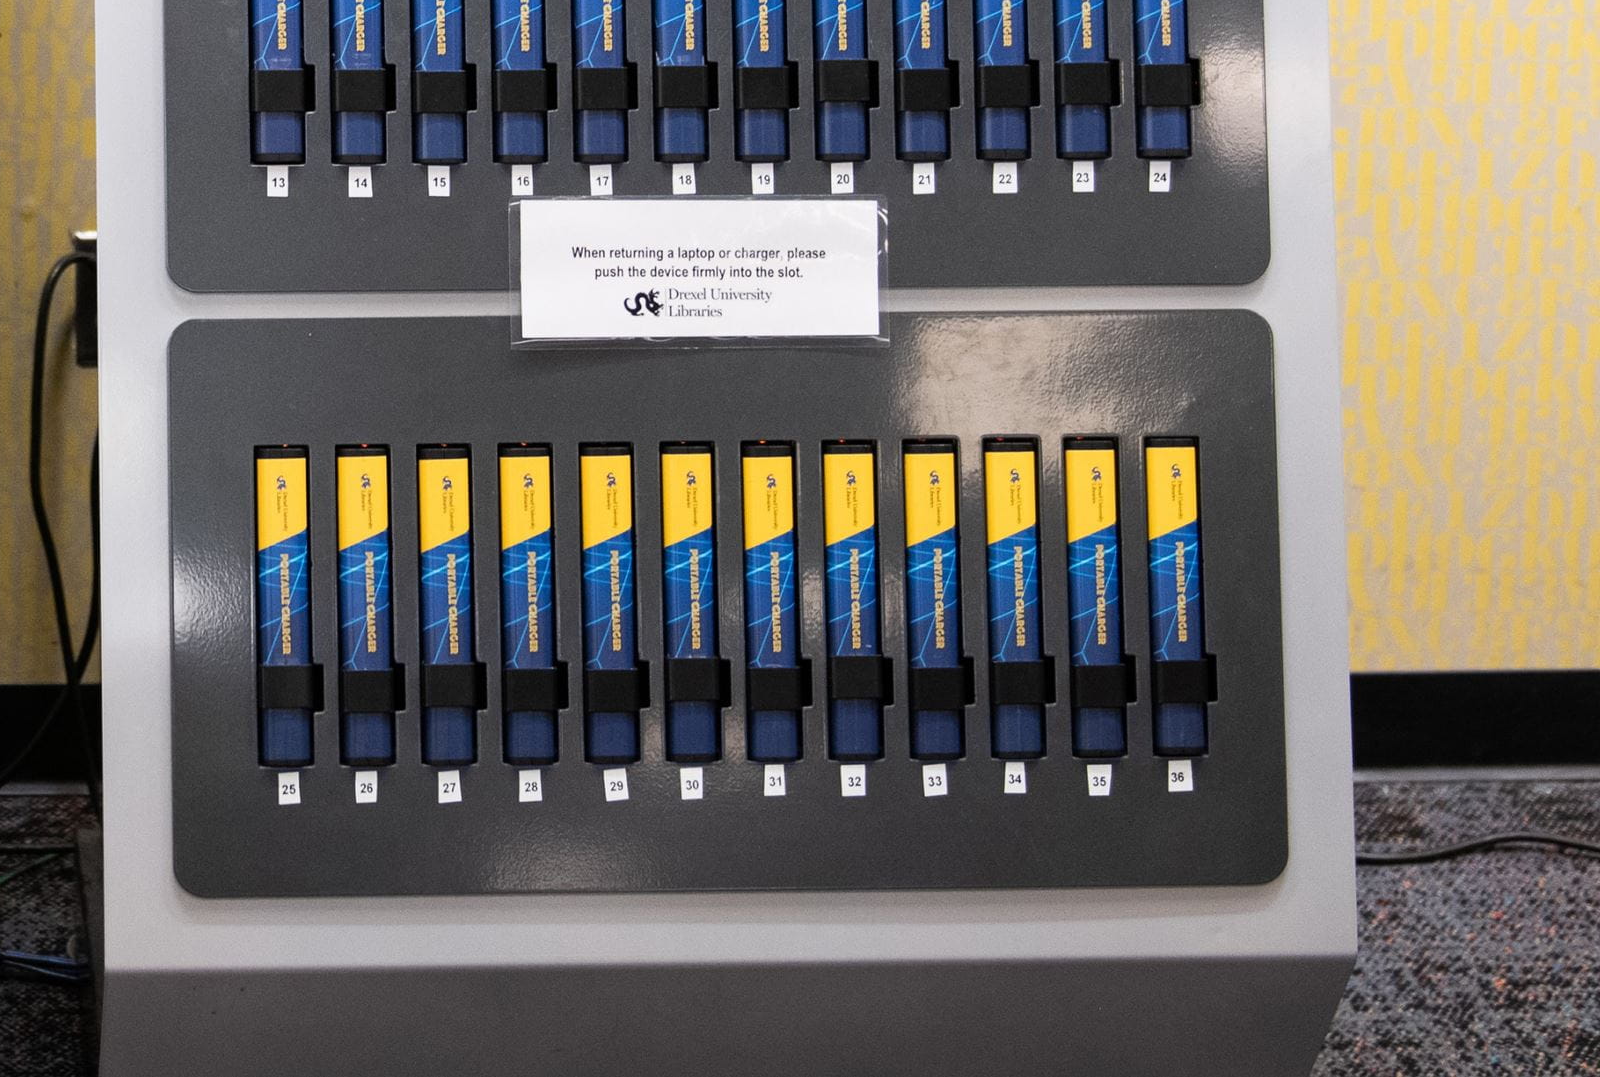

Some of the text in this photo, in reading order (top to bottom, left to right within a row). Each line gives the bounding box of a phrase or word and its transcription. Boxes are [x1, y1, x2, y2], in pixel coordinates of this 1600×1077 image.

[277, 3, 287, 50] CHARGER
[520, 5, 530, 52] CHARGER
[759, 5, 769, 52] CHARGER
[838, 3, 848, 51] CHARGER
[921, 1, 931, 49] CHARGER
[1082, 1, 1092, 49] CHARGER
[272, 178, 285, 187] 13
[355, 178, 367, 187] 14
[434, 177, 446, 187] 15
[517, 176, 529, 186] 16
[597, 176, 608, 186] 17
[679, 175, 692, 185] 18
[759, 175, 770, 184] 19
[837, 174, 849, 184] 20
[919, 175, 930, 184] 21
[999, 174, 1011, 184] 22
[1077, 173, 1089, 182] 23
[1154, 173, 1166, 182] 24
[572, 247, 825, 262] When returning a laptop or charger, please
[595, 266, 803, 280] push the device firmly into the slot.
[669, 288, 772, 303] Drexel University
[669, 305, 722, 316] Libraries
[1015, 546, 1026, 647] PORTABLE CHARGER
[1096, 545, 1107, 645] PORTABLE CHARGER
[1176, 542, 1188, 642] PORTABLE CHARGER
[366, 552, 377, 653] PORTABLE CHARGER
[528, 552, 539, 653] PORTABLE CHARGER
[611, 550, 622, 652] PORTABLE CHARGER
[691, 549, 701, 650] PORTABLE CHARGER
[771, 552, 782, 653] PORTABLE CHARGER
[850, 549, 862, 649] PORTABLE CHARGER
[934, 548, 945, 649] PORTABLE CHARGER
[281, 554, 292, 655] PORTABLE CHARGER
[448, 554, 459, 655] PORTABLE CHARGER
[770, 777, 781, 786] 31
[849, 777, 861, 787] 32
[929, 776, 942, 787] 33
[1009, 774, 1021, 784] 34
[1093, 777, 1106, 786] 35
[1171, 772, 1184, 782] 36
[282, 784, 295, 795] 25
[361, 783, 373, 793] 26
[443, 783, 455, 793] 27
[525, 782, 538, 792] 28
[610, 781, 623, 791] 29
[686, 780, 699, 790] 30
